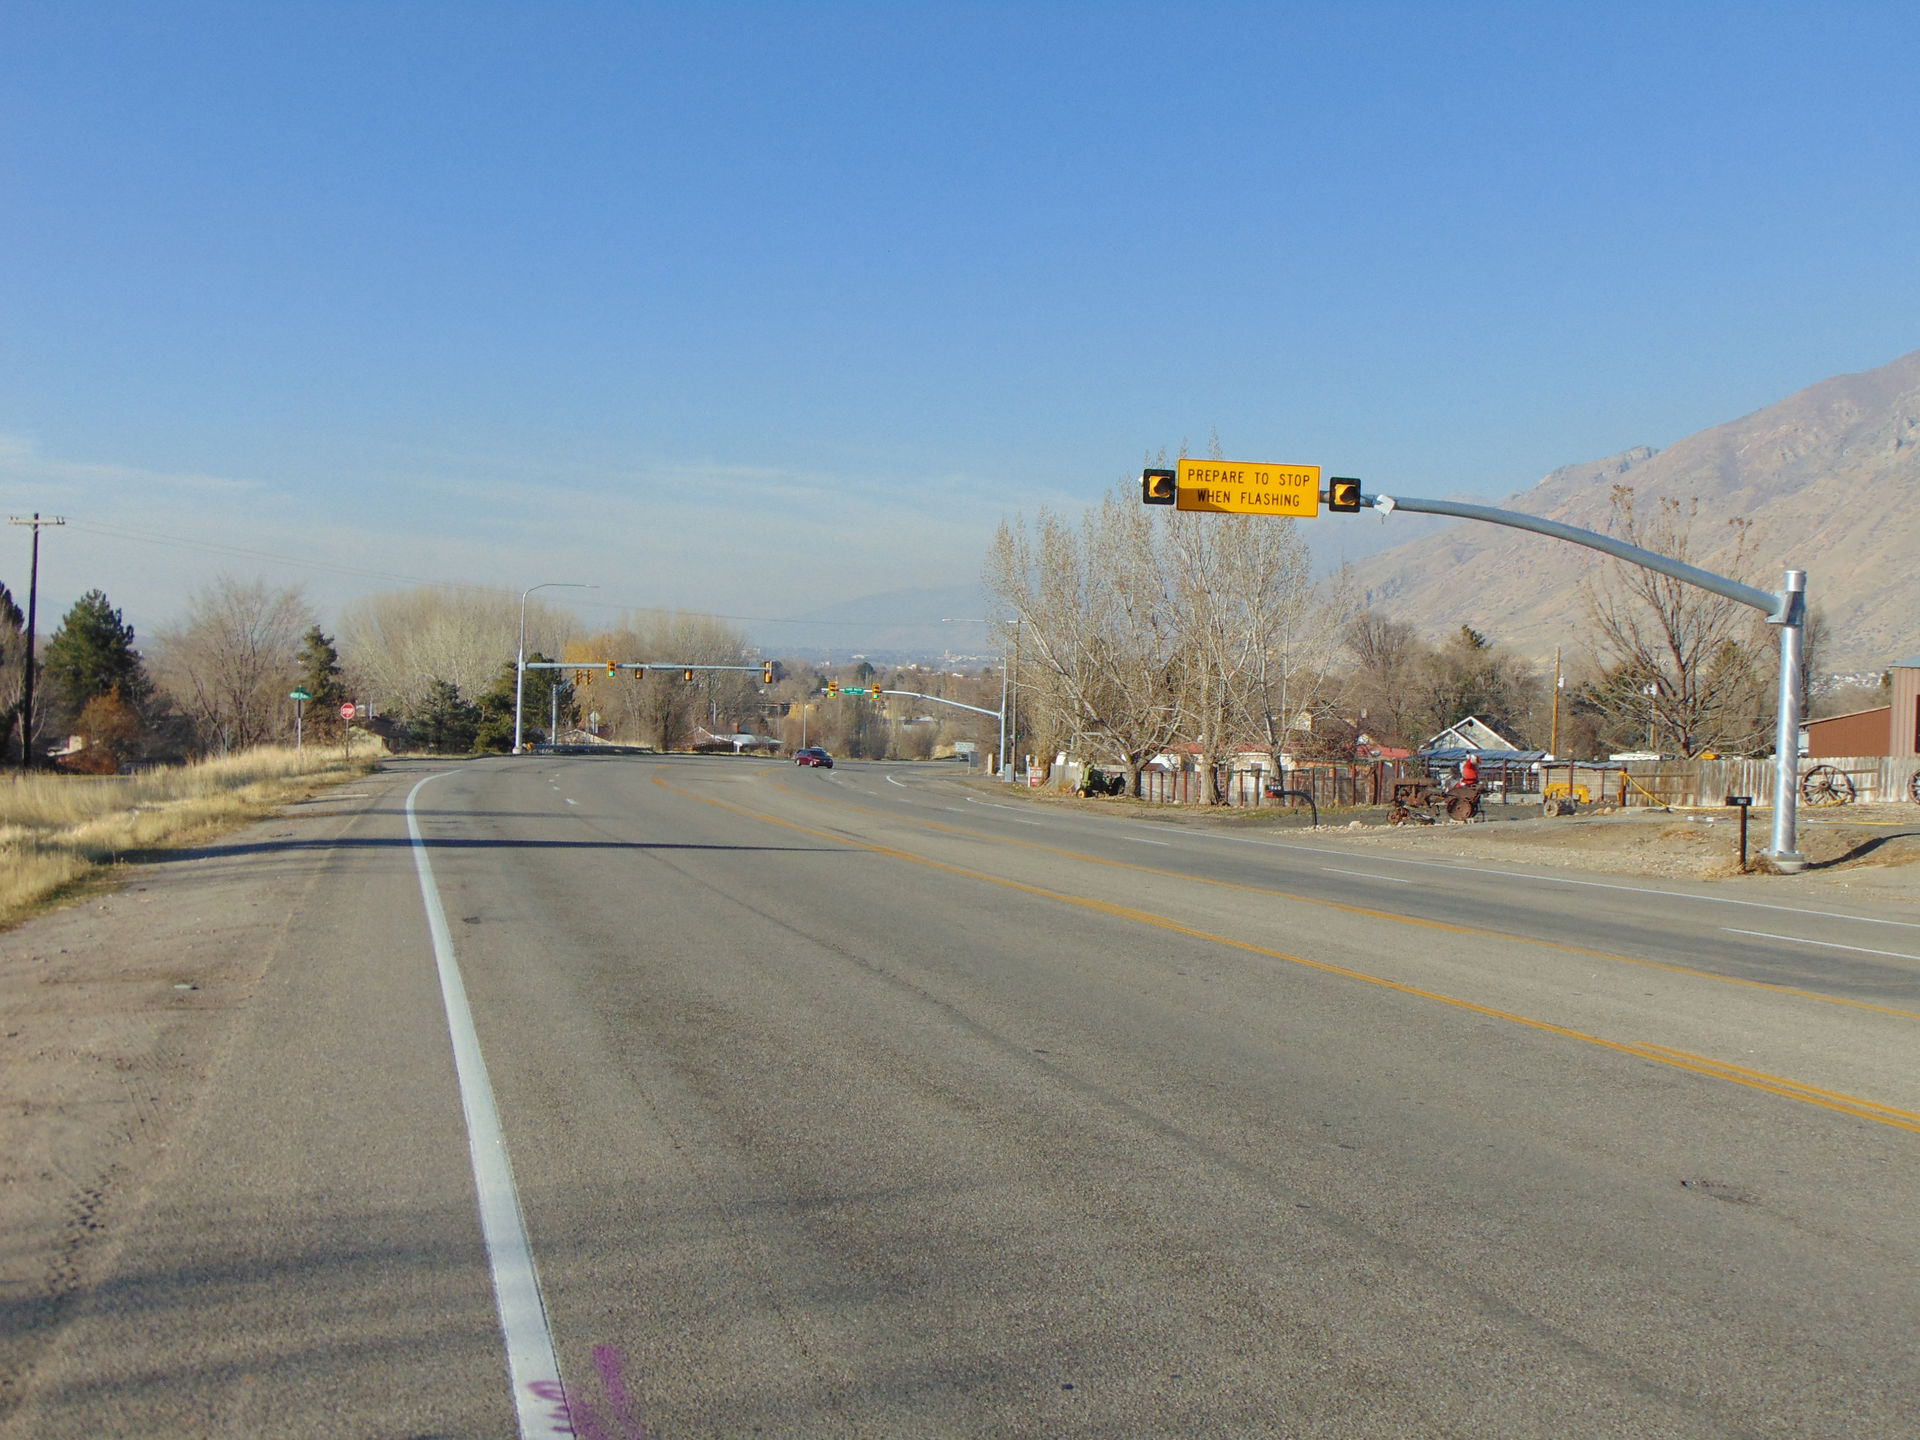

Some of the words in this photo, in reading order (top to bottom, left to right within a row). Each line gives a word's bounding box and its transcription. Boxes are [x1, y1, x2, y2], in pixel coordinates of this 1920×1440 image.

[1187, 468, 1244, 484] PREPARE
[1254, 472, 1269, 485] TO
[1279, 473, 1310, 486] STOP
[1197, 489, 1231, 504] WHEN
[1240, 492, 1300, 507] FLASHING
[342, 707, 355, 715] STOP
